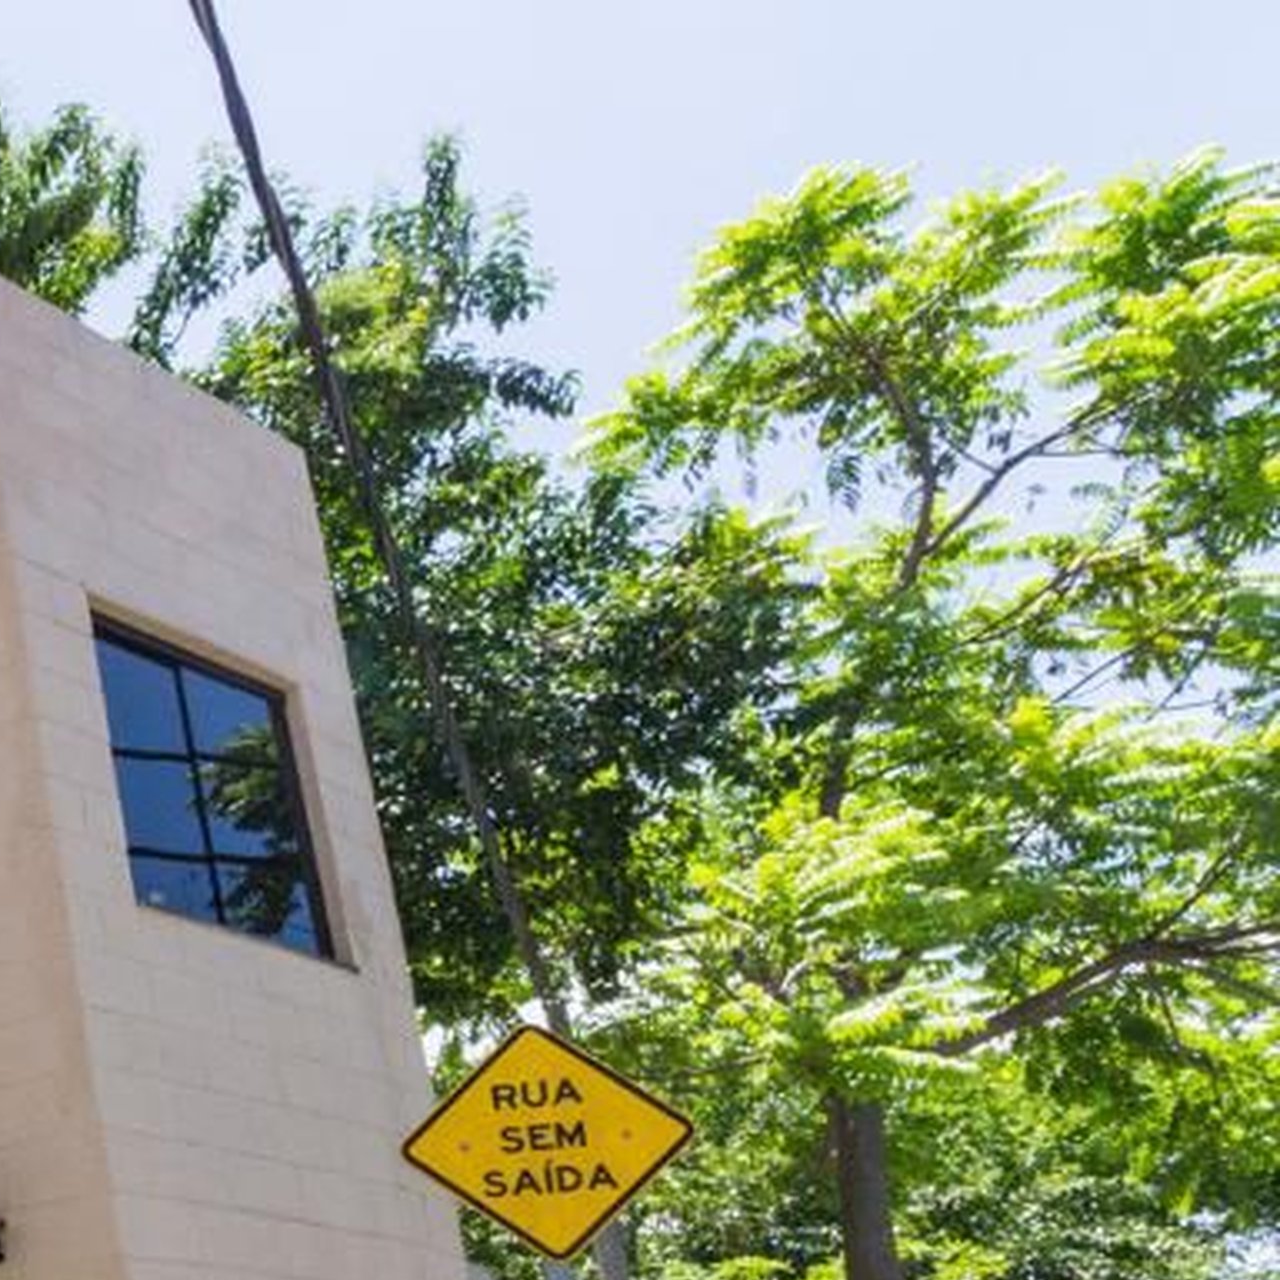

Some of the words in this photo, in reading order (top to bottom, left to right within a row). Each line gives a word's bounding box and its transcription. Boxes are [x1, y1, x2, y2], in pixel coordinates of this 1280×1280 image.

[491, 1077, 583, 1111] RUA
[500, 1120, 588, 1154] SEM
[482, 1158, 619, 1198] SAÍDA
